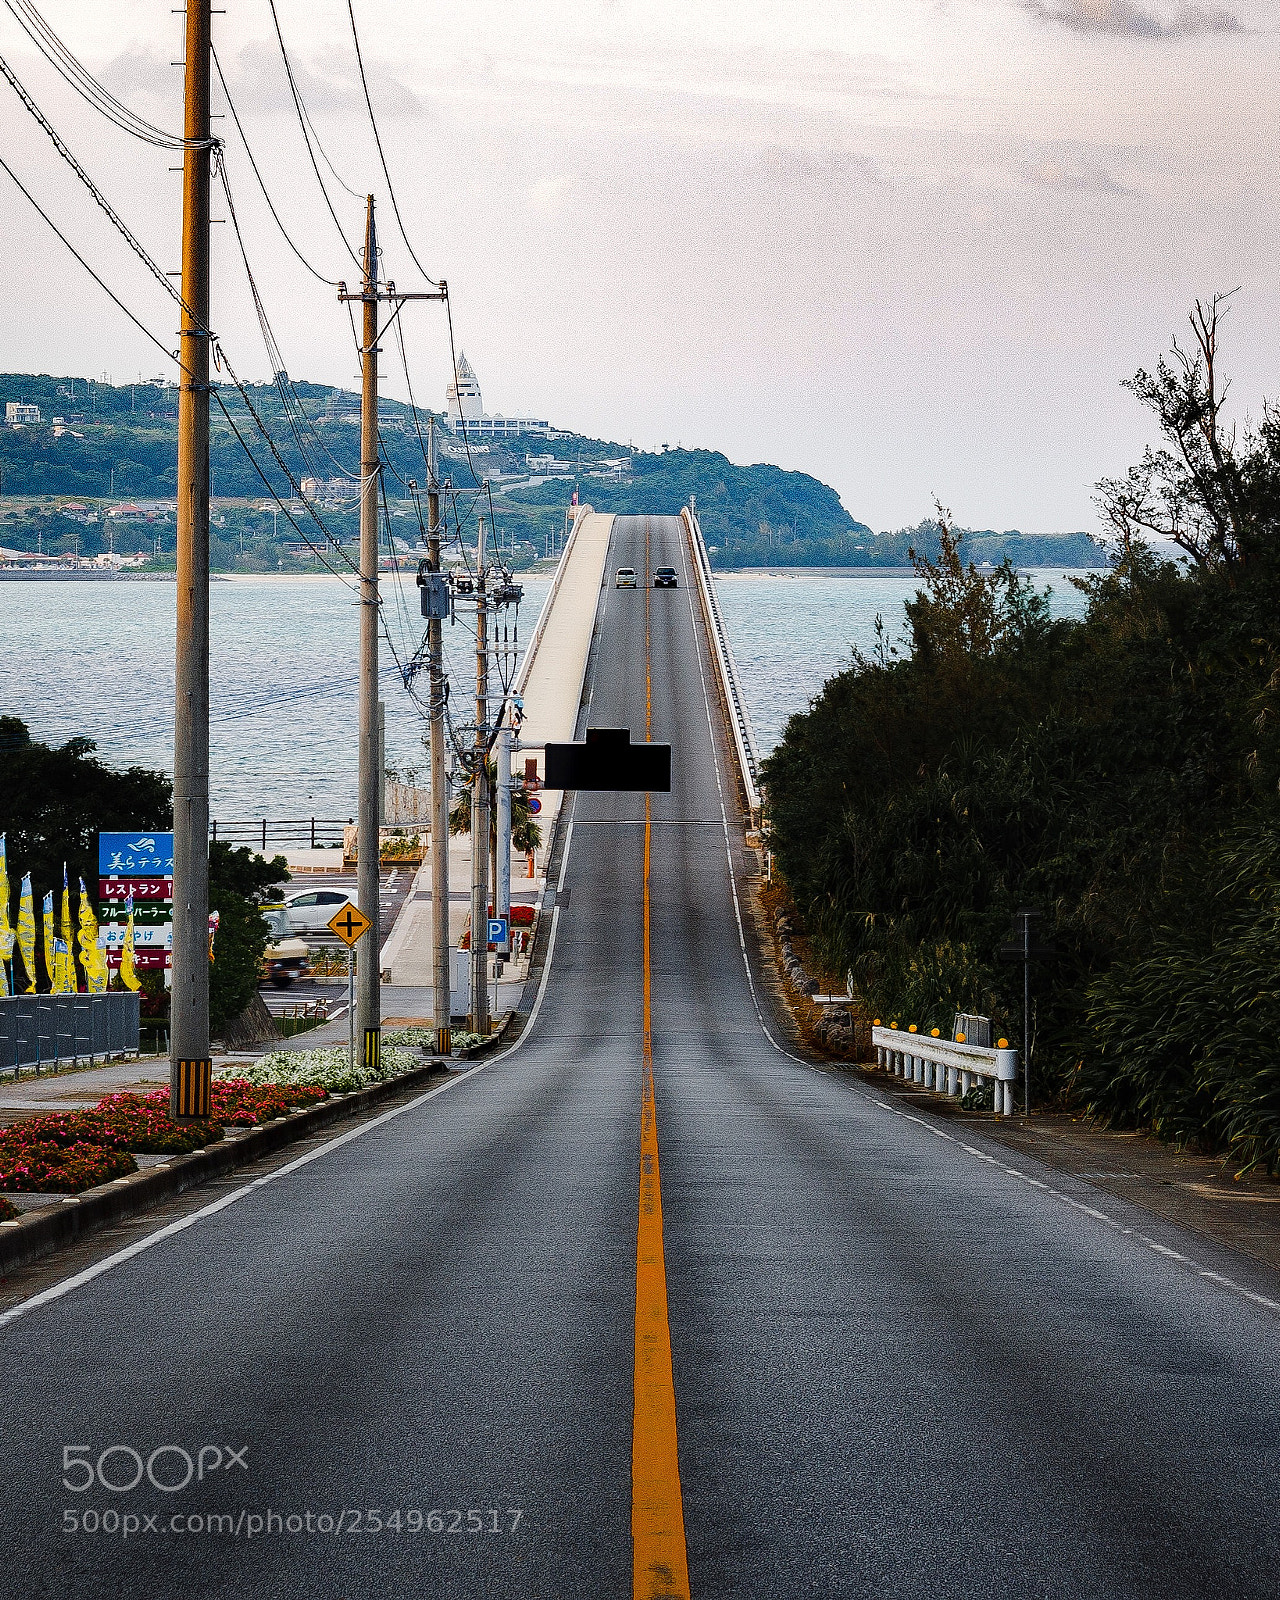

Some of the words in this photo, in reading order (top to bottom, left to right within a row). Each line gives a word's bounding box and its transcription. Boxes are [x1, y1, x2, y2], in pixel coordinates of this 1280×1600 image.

[107, 851, 174, 870] 美らテラス
[105, 883, 161, 895] レストラン
[101, 907, 167, 918] フルーパーラー
[489, 922, 502, 940] P
[106, 954, 160, 965] バーキュー
